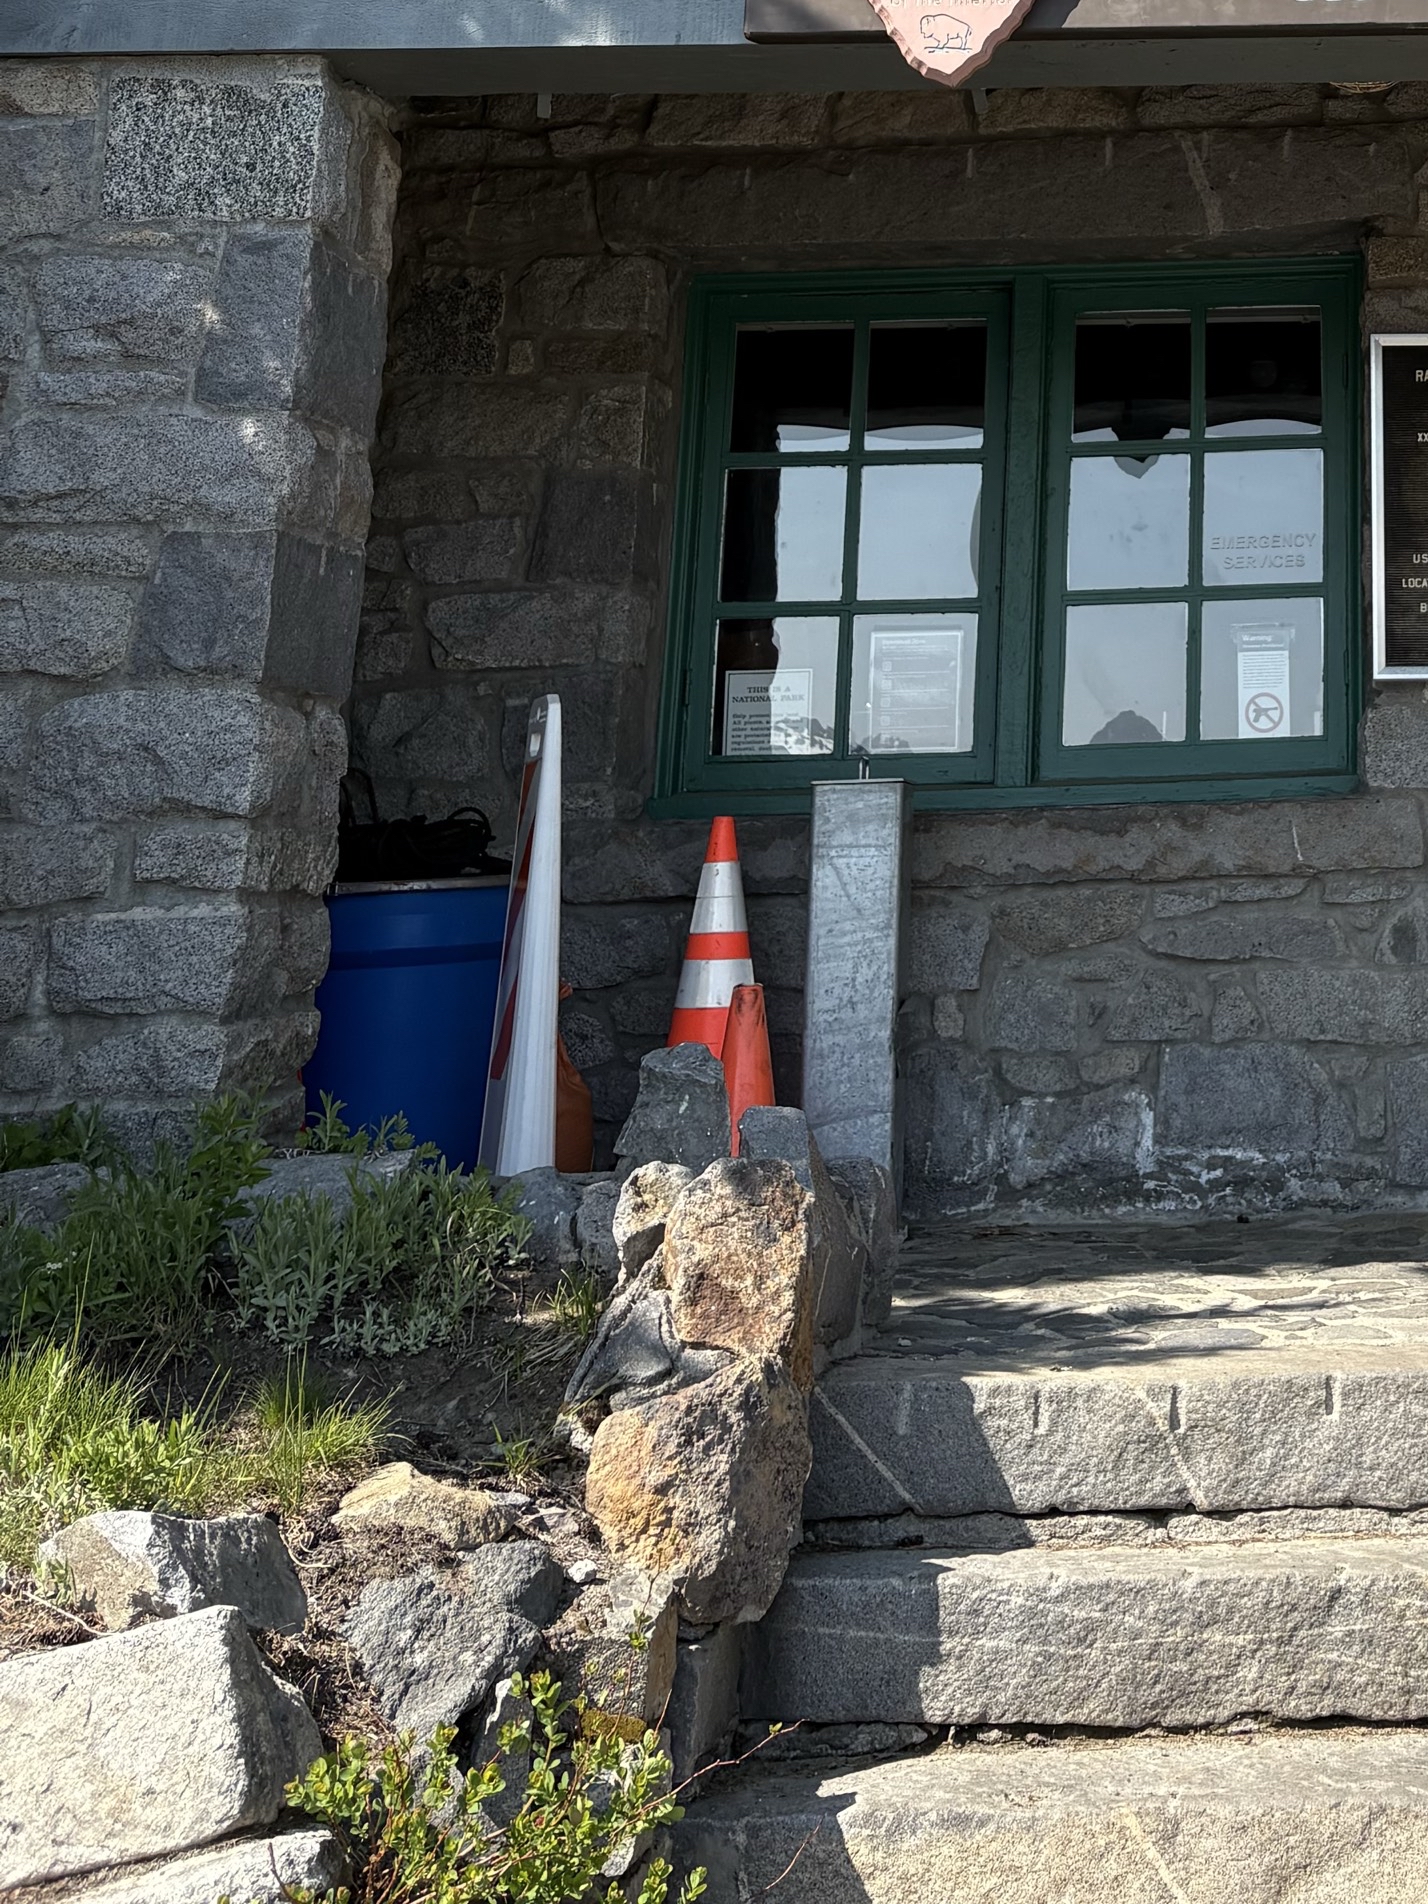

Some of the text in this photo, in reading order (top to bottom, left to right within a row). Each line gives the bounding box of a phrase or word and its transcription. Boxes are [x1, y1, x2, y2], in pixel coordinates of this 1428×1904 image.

[1210, 533, 1317, 550] EMERGENCY
[1223, 554, 1306, 570] SERVICES
[747, 686, 770, 694] THIS
[731, 694, 806, 703] NATIONAL PARK
